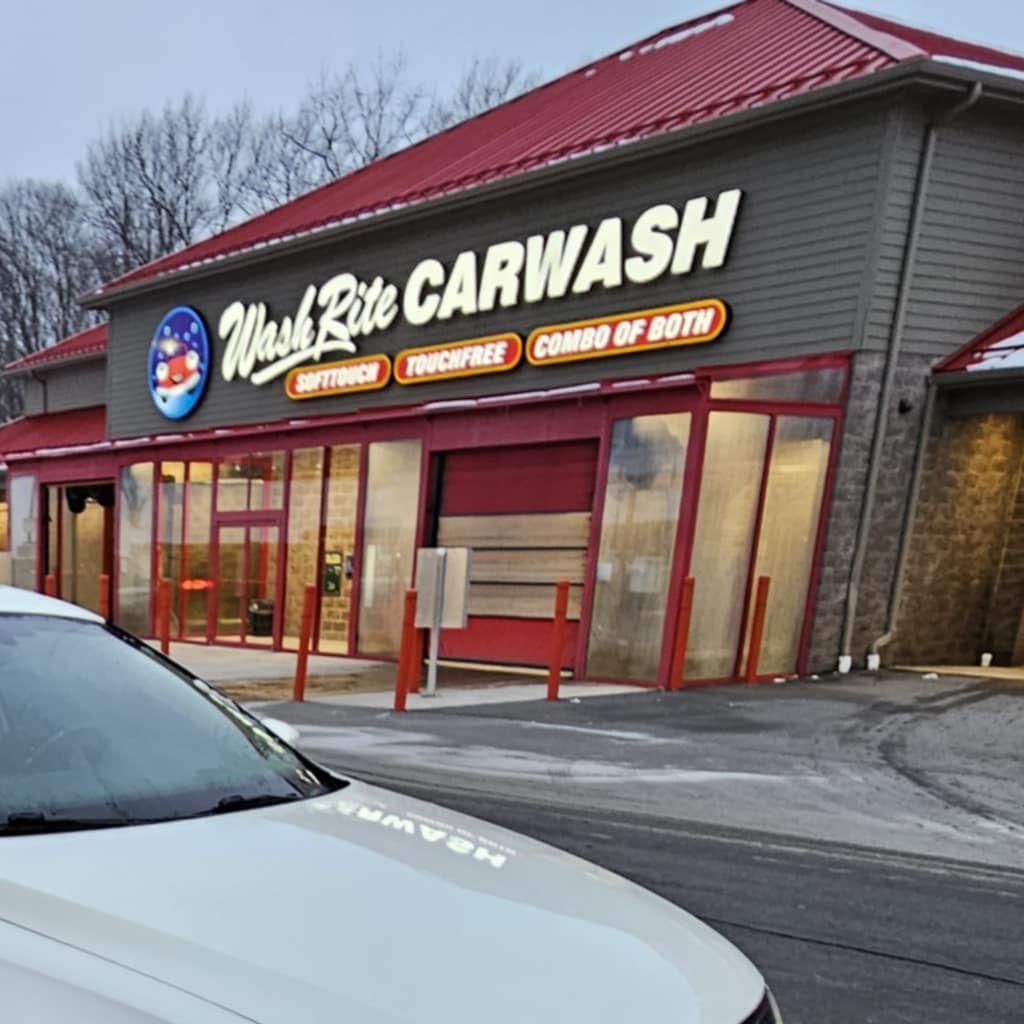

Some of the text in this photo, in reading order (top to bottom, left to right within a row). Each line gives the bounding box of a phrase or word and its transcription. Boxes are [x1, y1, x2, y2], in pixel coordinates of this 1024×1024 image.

[219, 189, 742, 382] Wash Rite CARWASH
[533, 307, 716, 359] COMBO OF BOTH
[295, 361, 380, 393] SOFTTOUCH
[405, 341, 508, 377] TOUCHFREE
